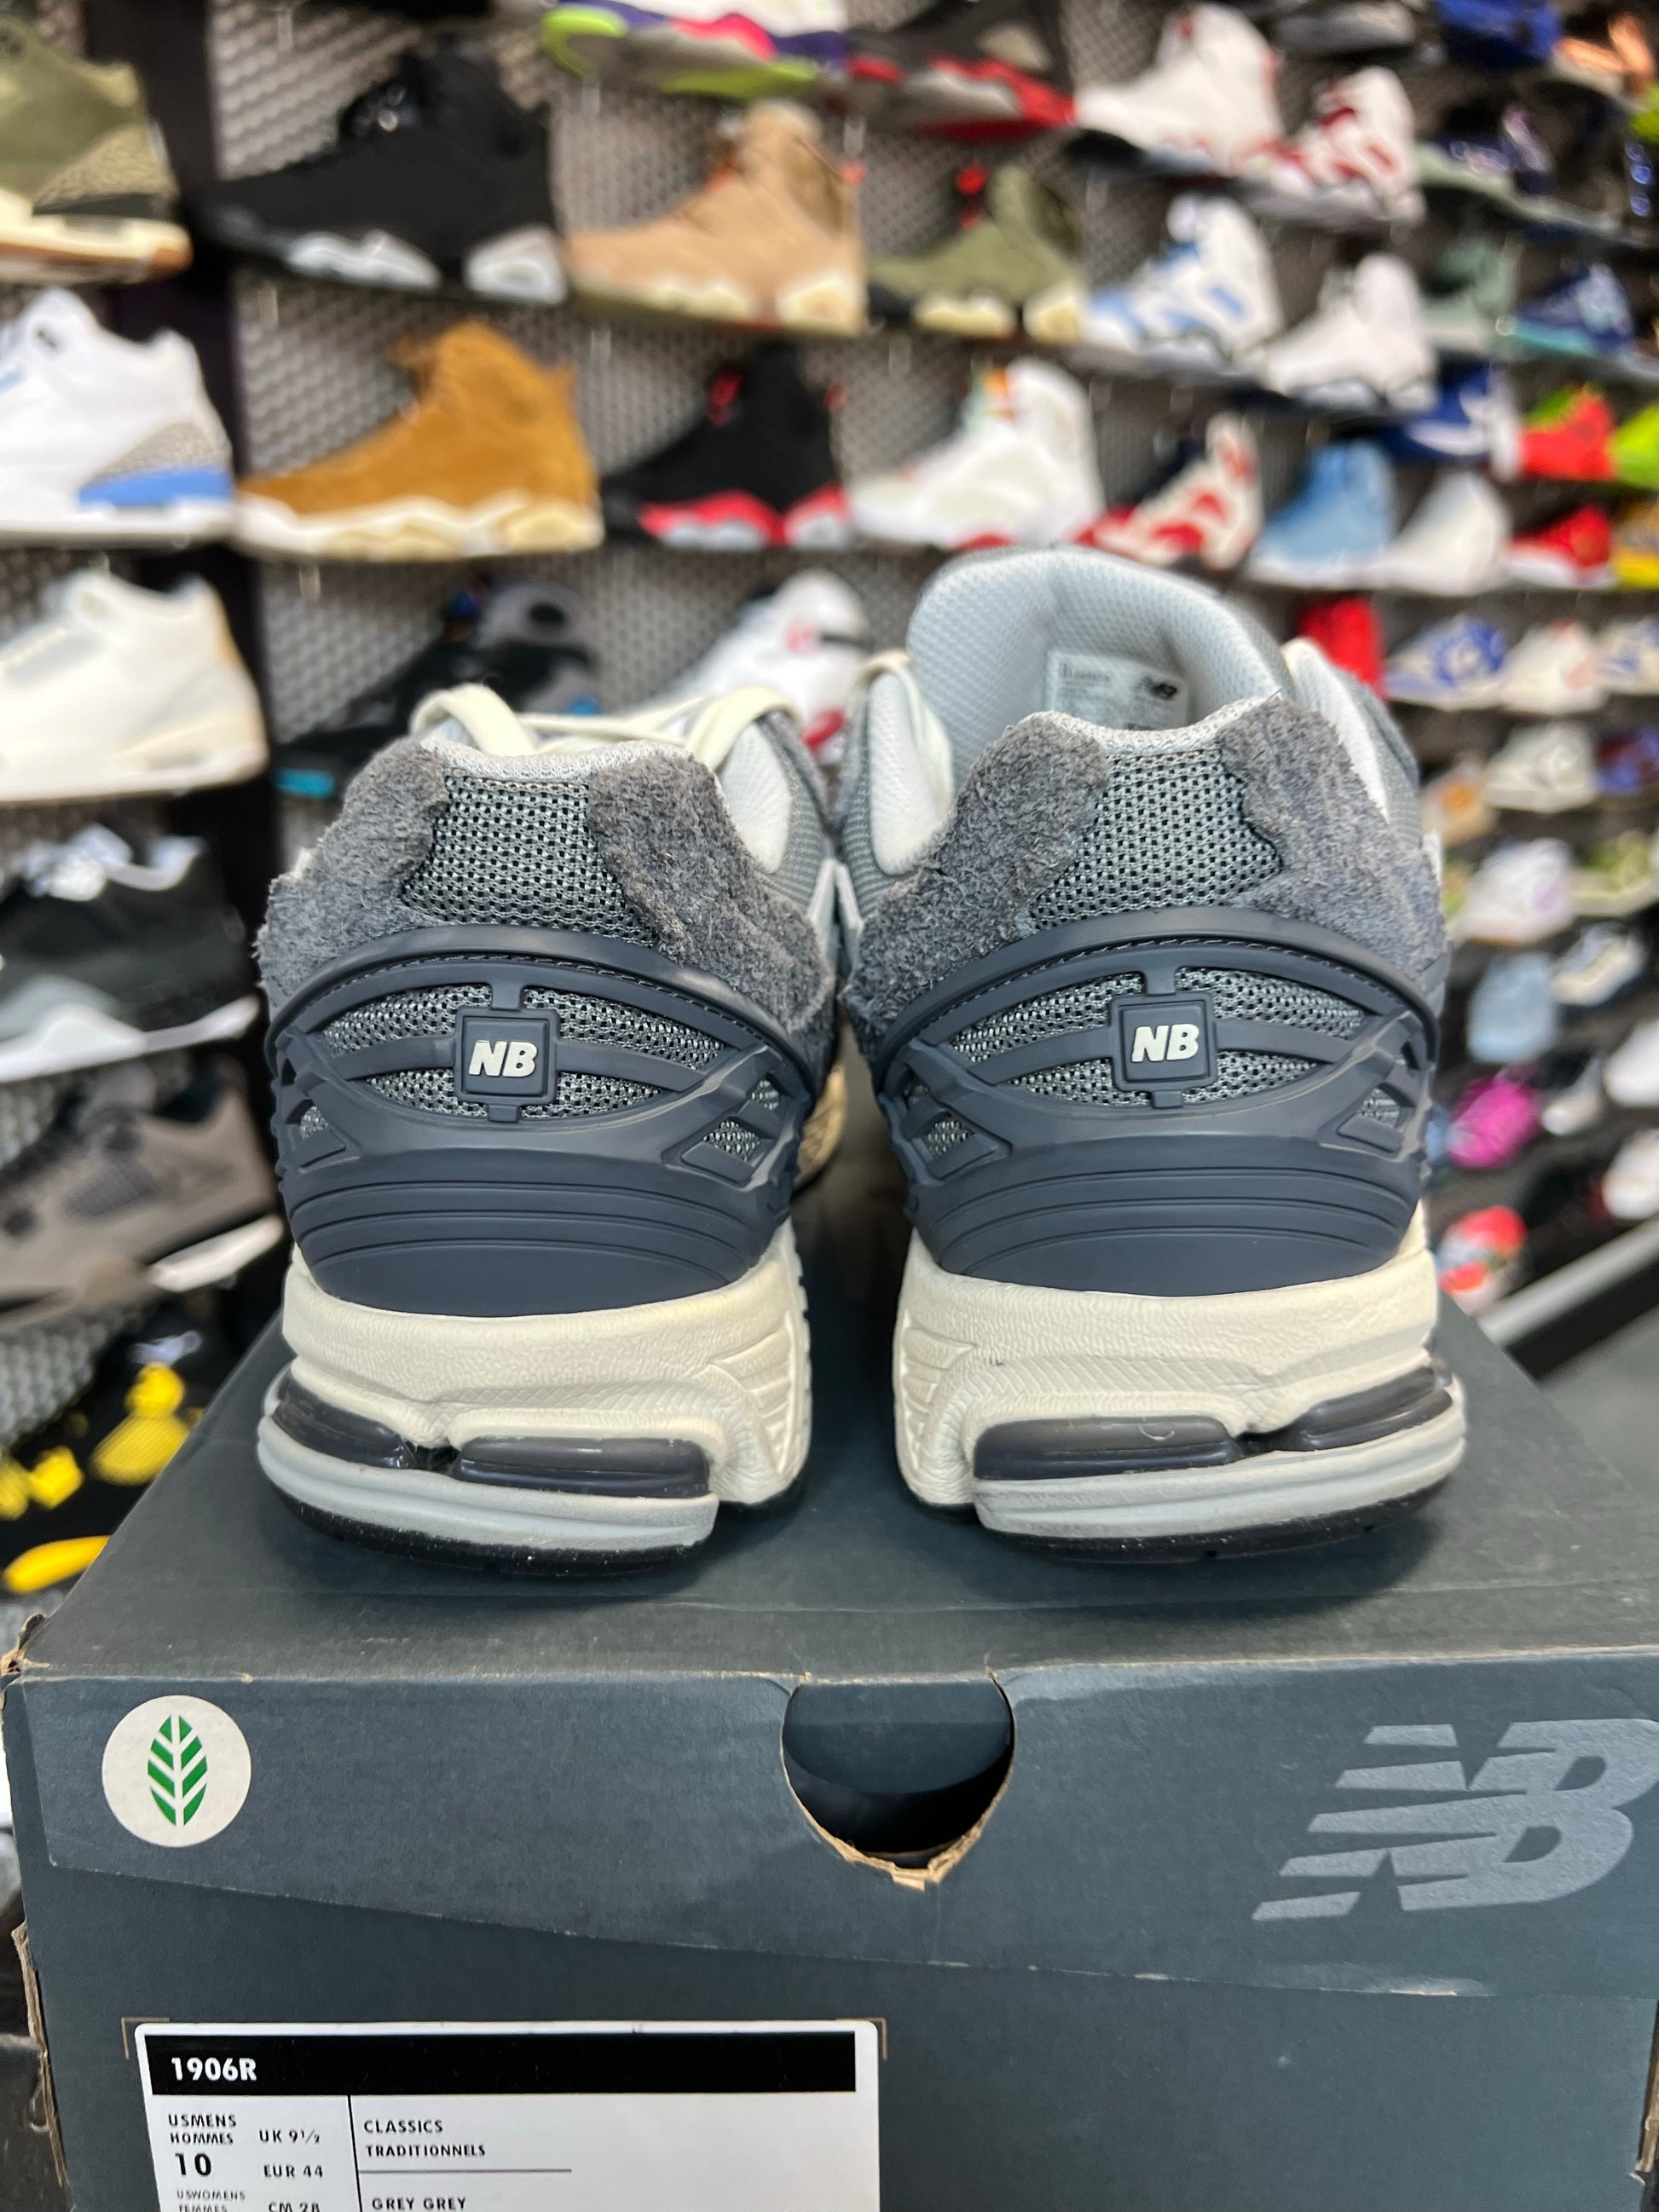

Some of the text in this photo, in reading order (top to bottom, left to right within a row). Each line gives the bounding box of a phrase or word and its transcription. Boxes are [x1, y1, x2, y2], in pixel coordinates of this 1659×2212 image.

[1131, 1024, 1199, 1062] NB
[468, 1040, 537, 1077] NB
[1251, 1718, 1659, 1921] NB
[171, 2056, 257, 2082] 1906R
[168, 2114, 237, 2128] USMENS
[363, 2120, 443, 2134] CLASSICS
[171, 2133, 234, 2145] HOMMES
[259, 2130, 282, 2143] UK
[366, 2145, 486, 2157] TRADITIONNELS
[175, 2152, 212, 2176] 10
[263, 2164, 324, 2178] EUR 44
[176, 2189, 246, 2201] USWOMENS
[269, 2202, 292, 2212] CM
[372, 2198, 466, 2210] GREY GREY
